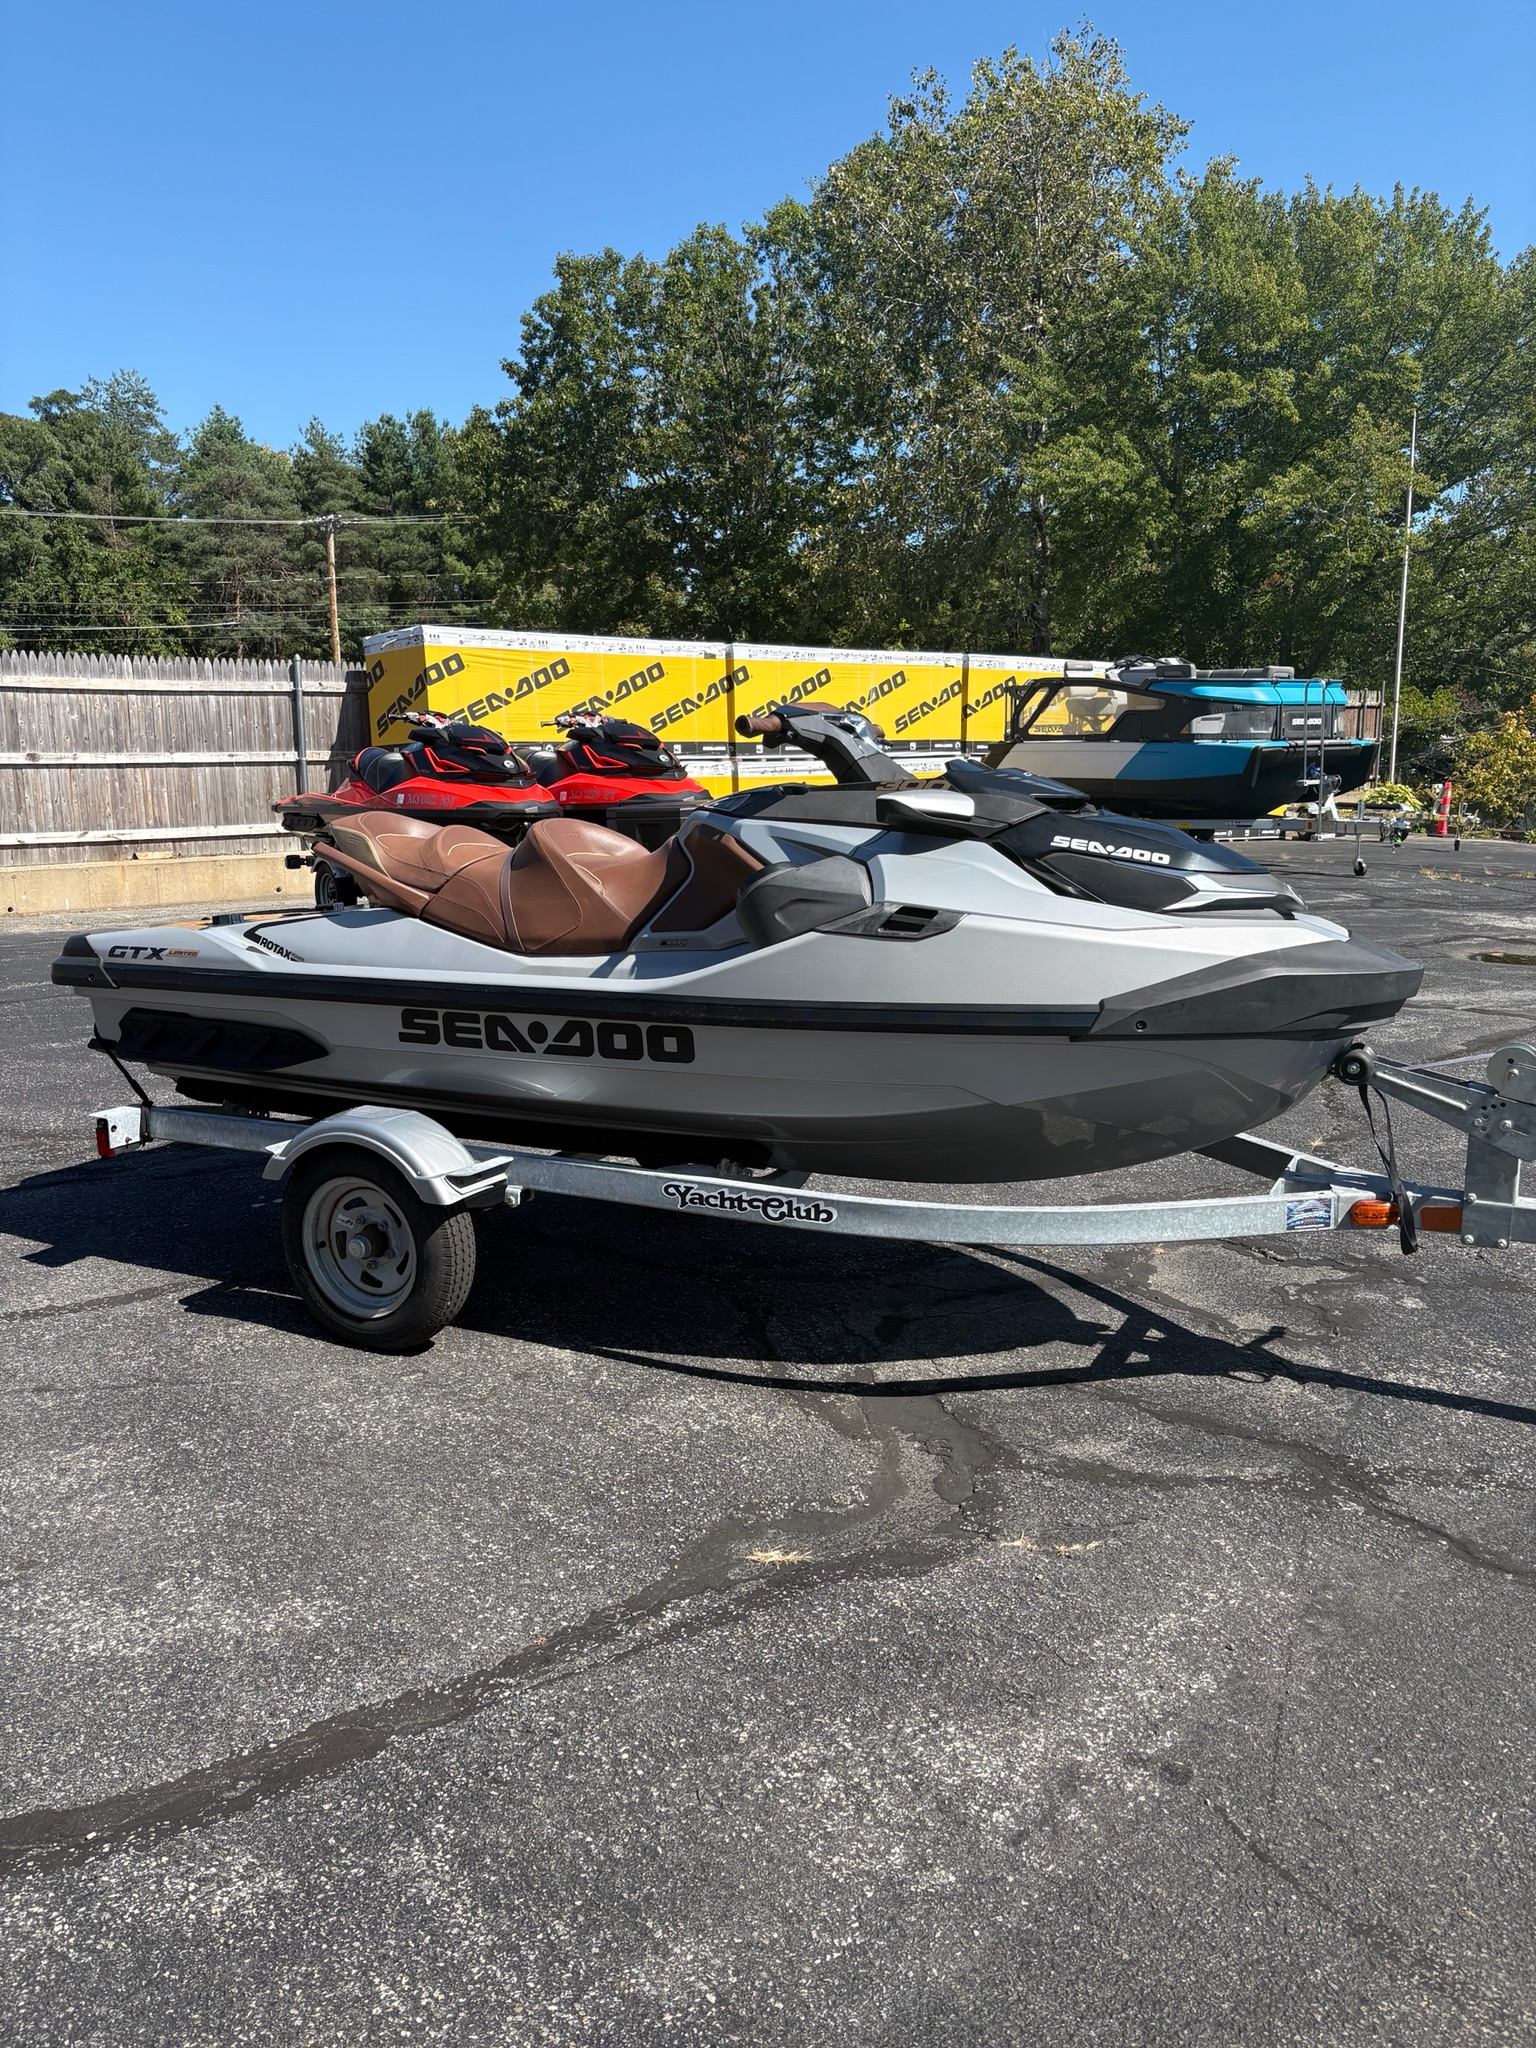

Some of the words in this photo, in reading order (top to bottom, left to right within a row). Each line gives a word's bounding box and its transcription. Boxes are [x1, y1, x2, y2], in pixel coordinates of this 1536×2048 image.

[876, 780, 952, 791] 300
[108, 945, 169, 961] GTX
[168, 949, 198, 958] LIMITED
[260, 937, 293, 961] ROTAX
